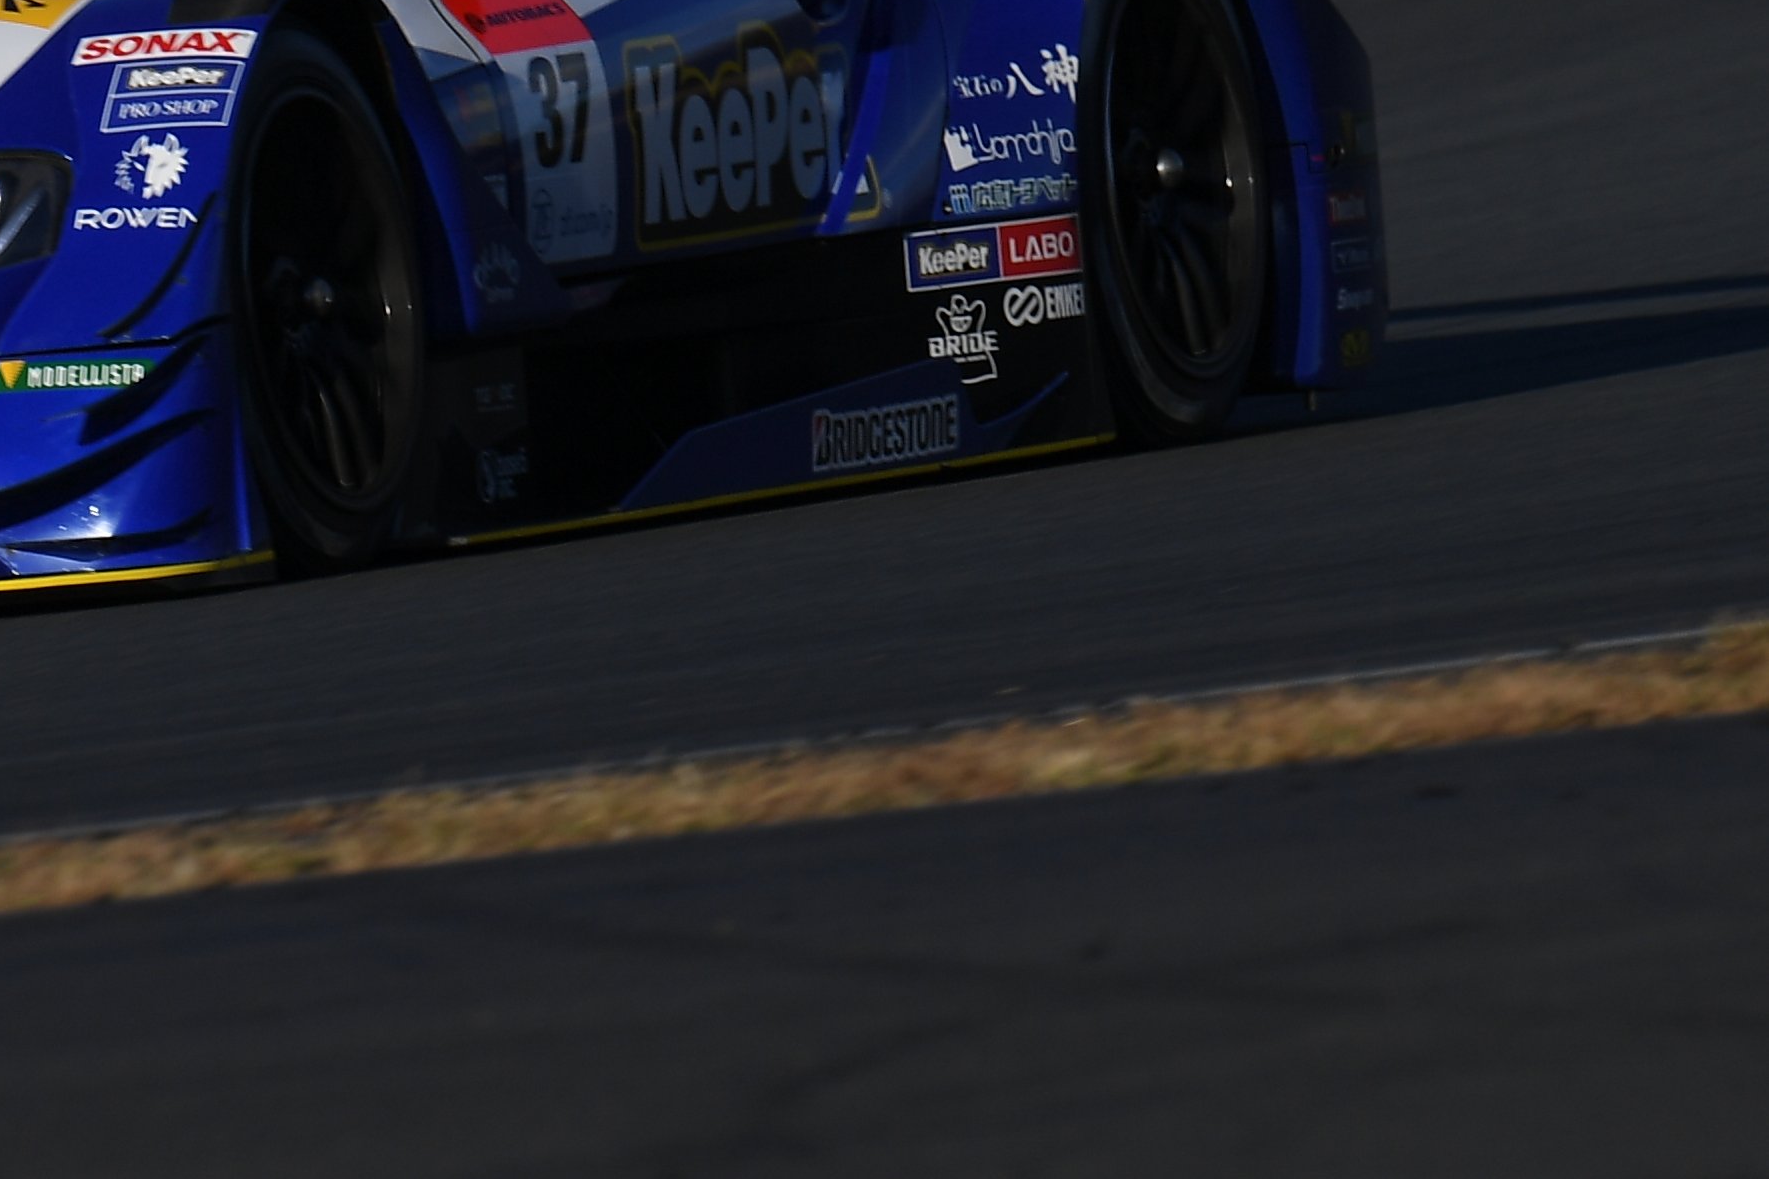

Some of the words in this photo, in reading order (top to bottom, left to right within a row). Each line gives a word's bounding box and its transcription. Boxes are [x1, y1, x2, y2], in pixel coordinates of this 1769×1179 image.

[81, 30, 241, 61] SONAX
[128, 66, 225, 90] KeePer
[117, 99, 161, 119] PRO
[161, 96, 219, 119] SHOP
[528, 52, 589, 169] 37
[632, 45, 871, 226] KeePer
[73, 206, 199, 230] ROWEN
[918, 240, 990, 276] KeePer
[1008, 231, 1075, 263] LABO
[927, 330, 1000, 358] BRIDE
[27, 363, 146, 388] MODELLISTA
[813, 395, 958, 470] BRIDGESTONE
